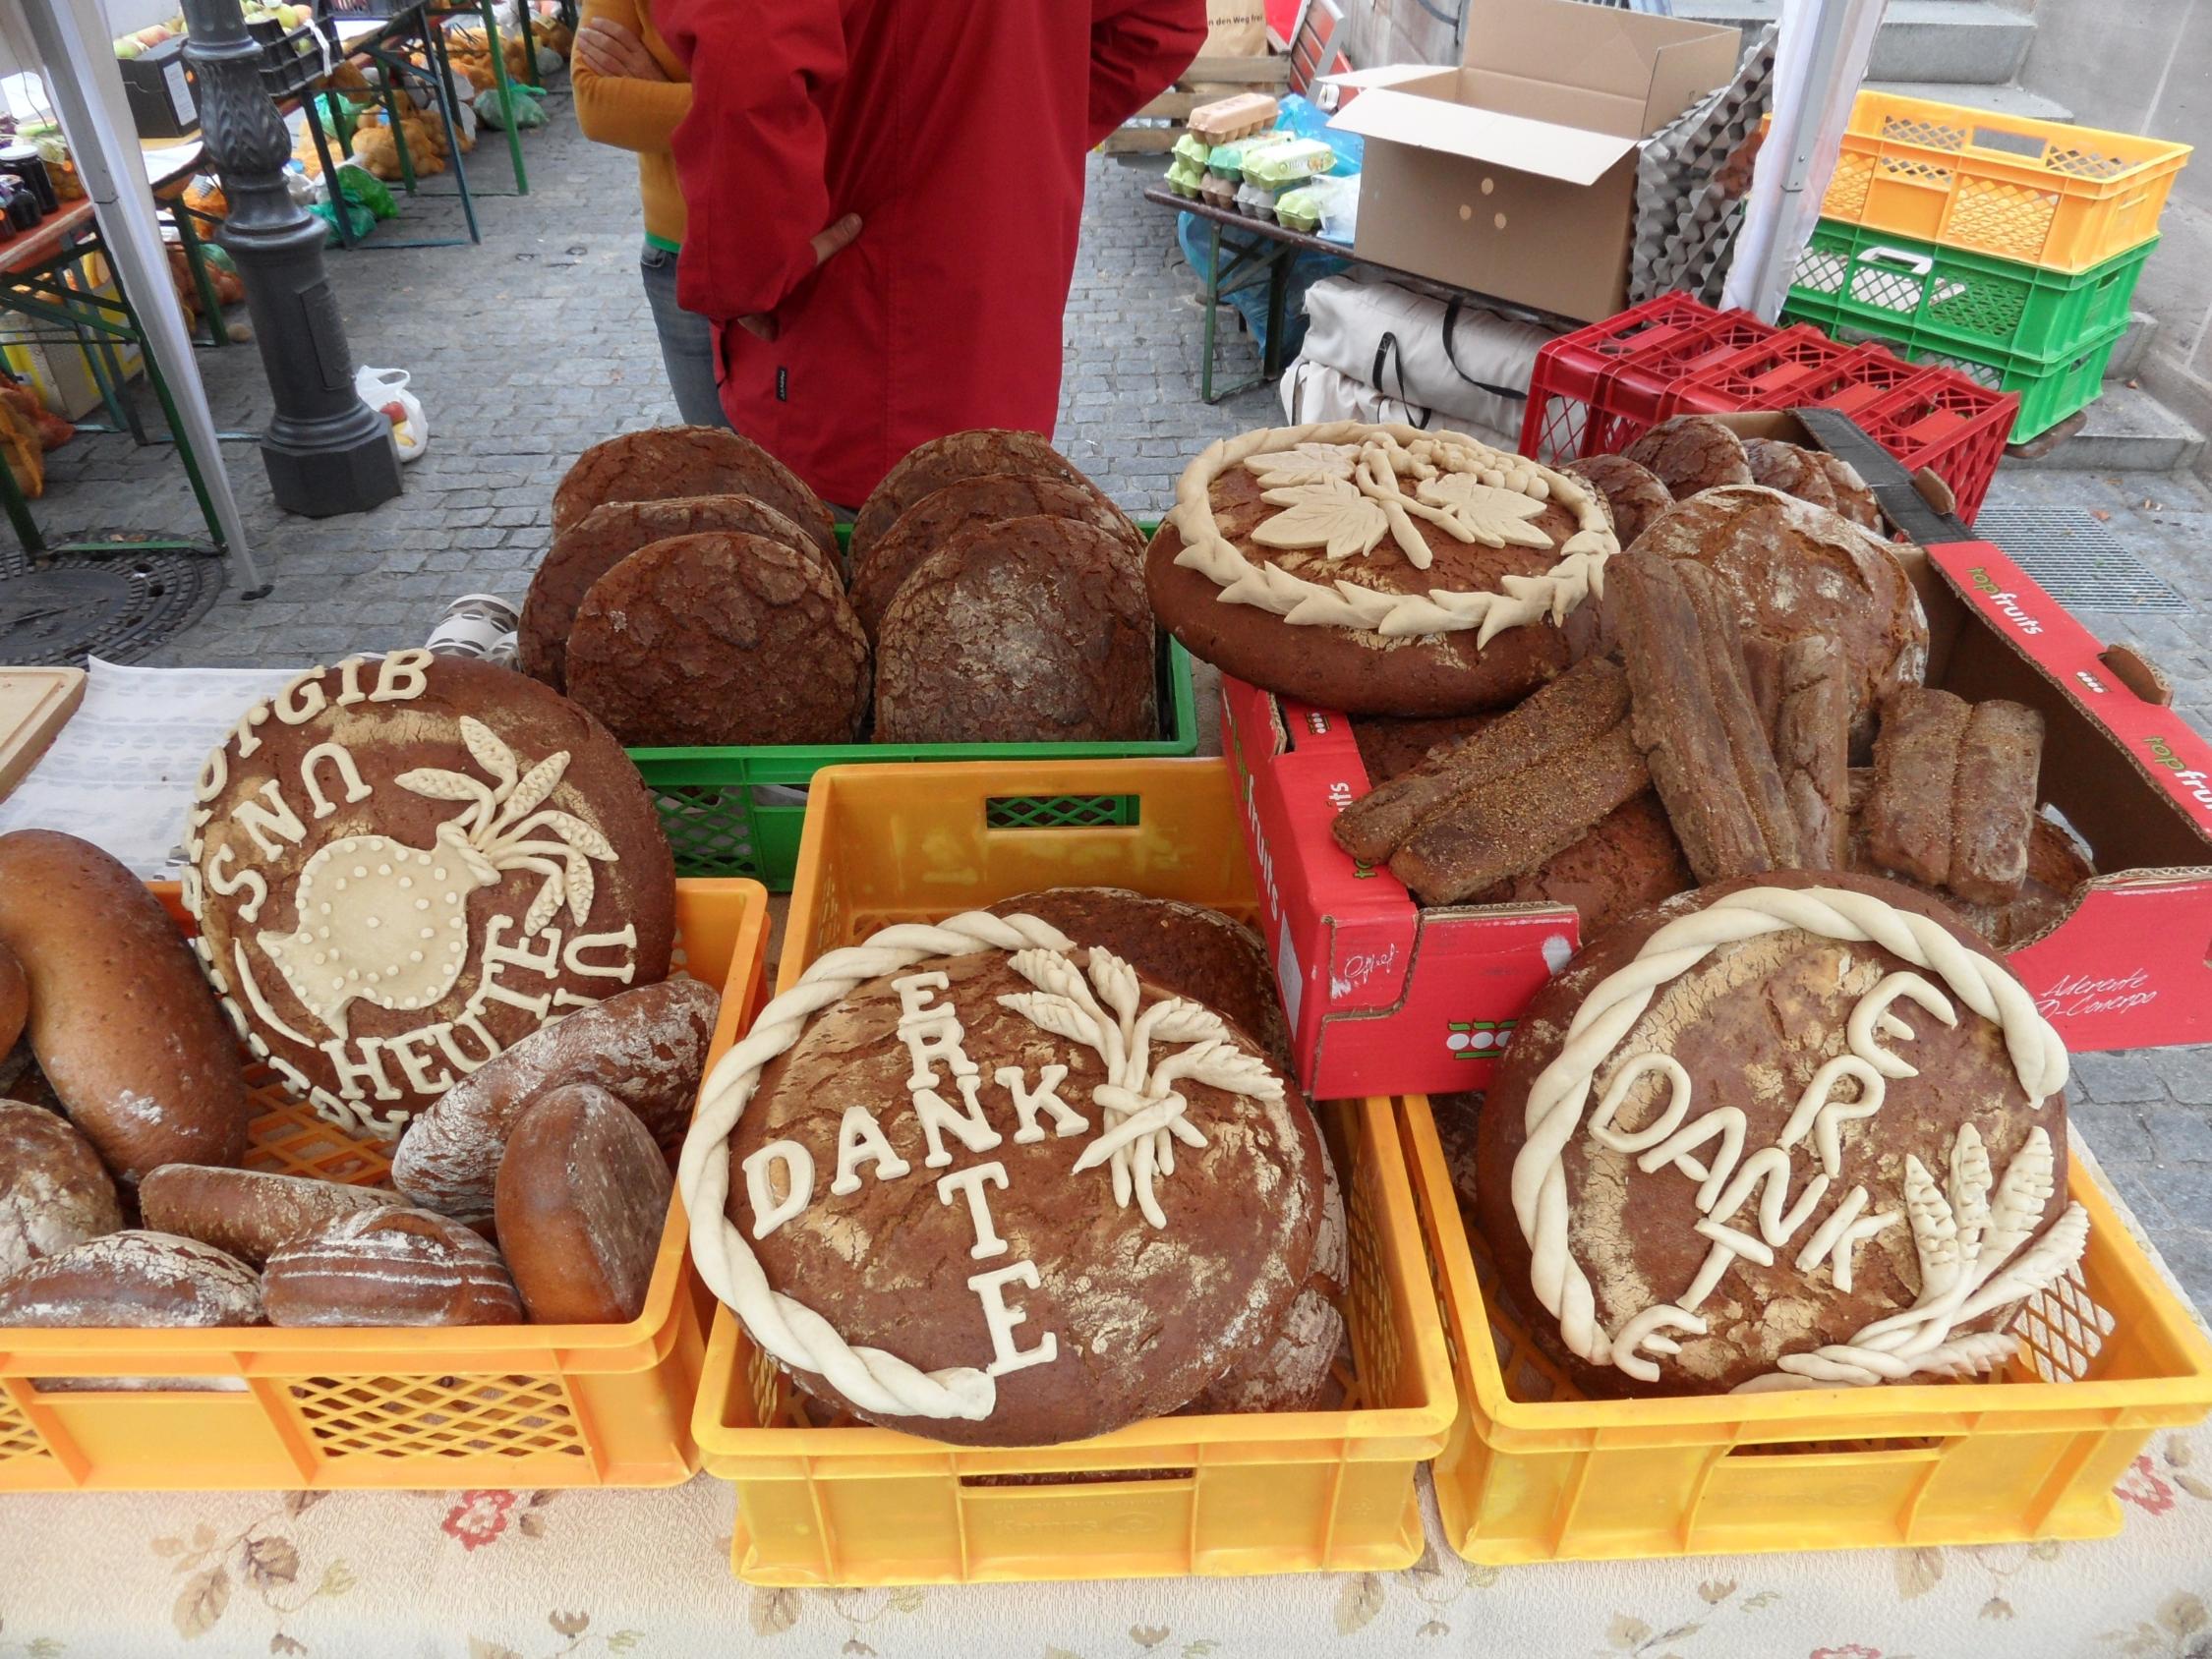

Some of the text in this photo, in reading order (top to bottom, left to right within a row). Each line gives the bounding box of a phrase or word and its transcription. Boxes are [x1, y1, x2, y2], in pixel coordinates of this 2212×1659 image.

[1215, 17, 1232, 27] den
[1233, 15, 1251, 25] Weg
[1966, 566, 2044, 635] topfruits
[320, 914, 563, 1101] HEUTE
[742, 1064, 1089, 1241] DANK
[891, 971, 1058, 1377] ERNTE
[1588, 1051, 1901, 1294] DANK
